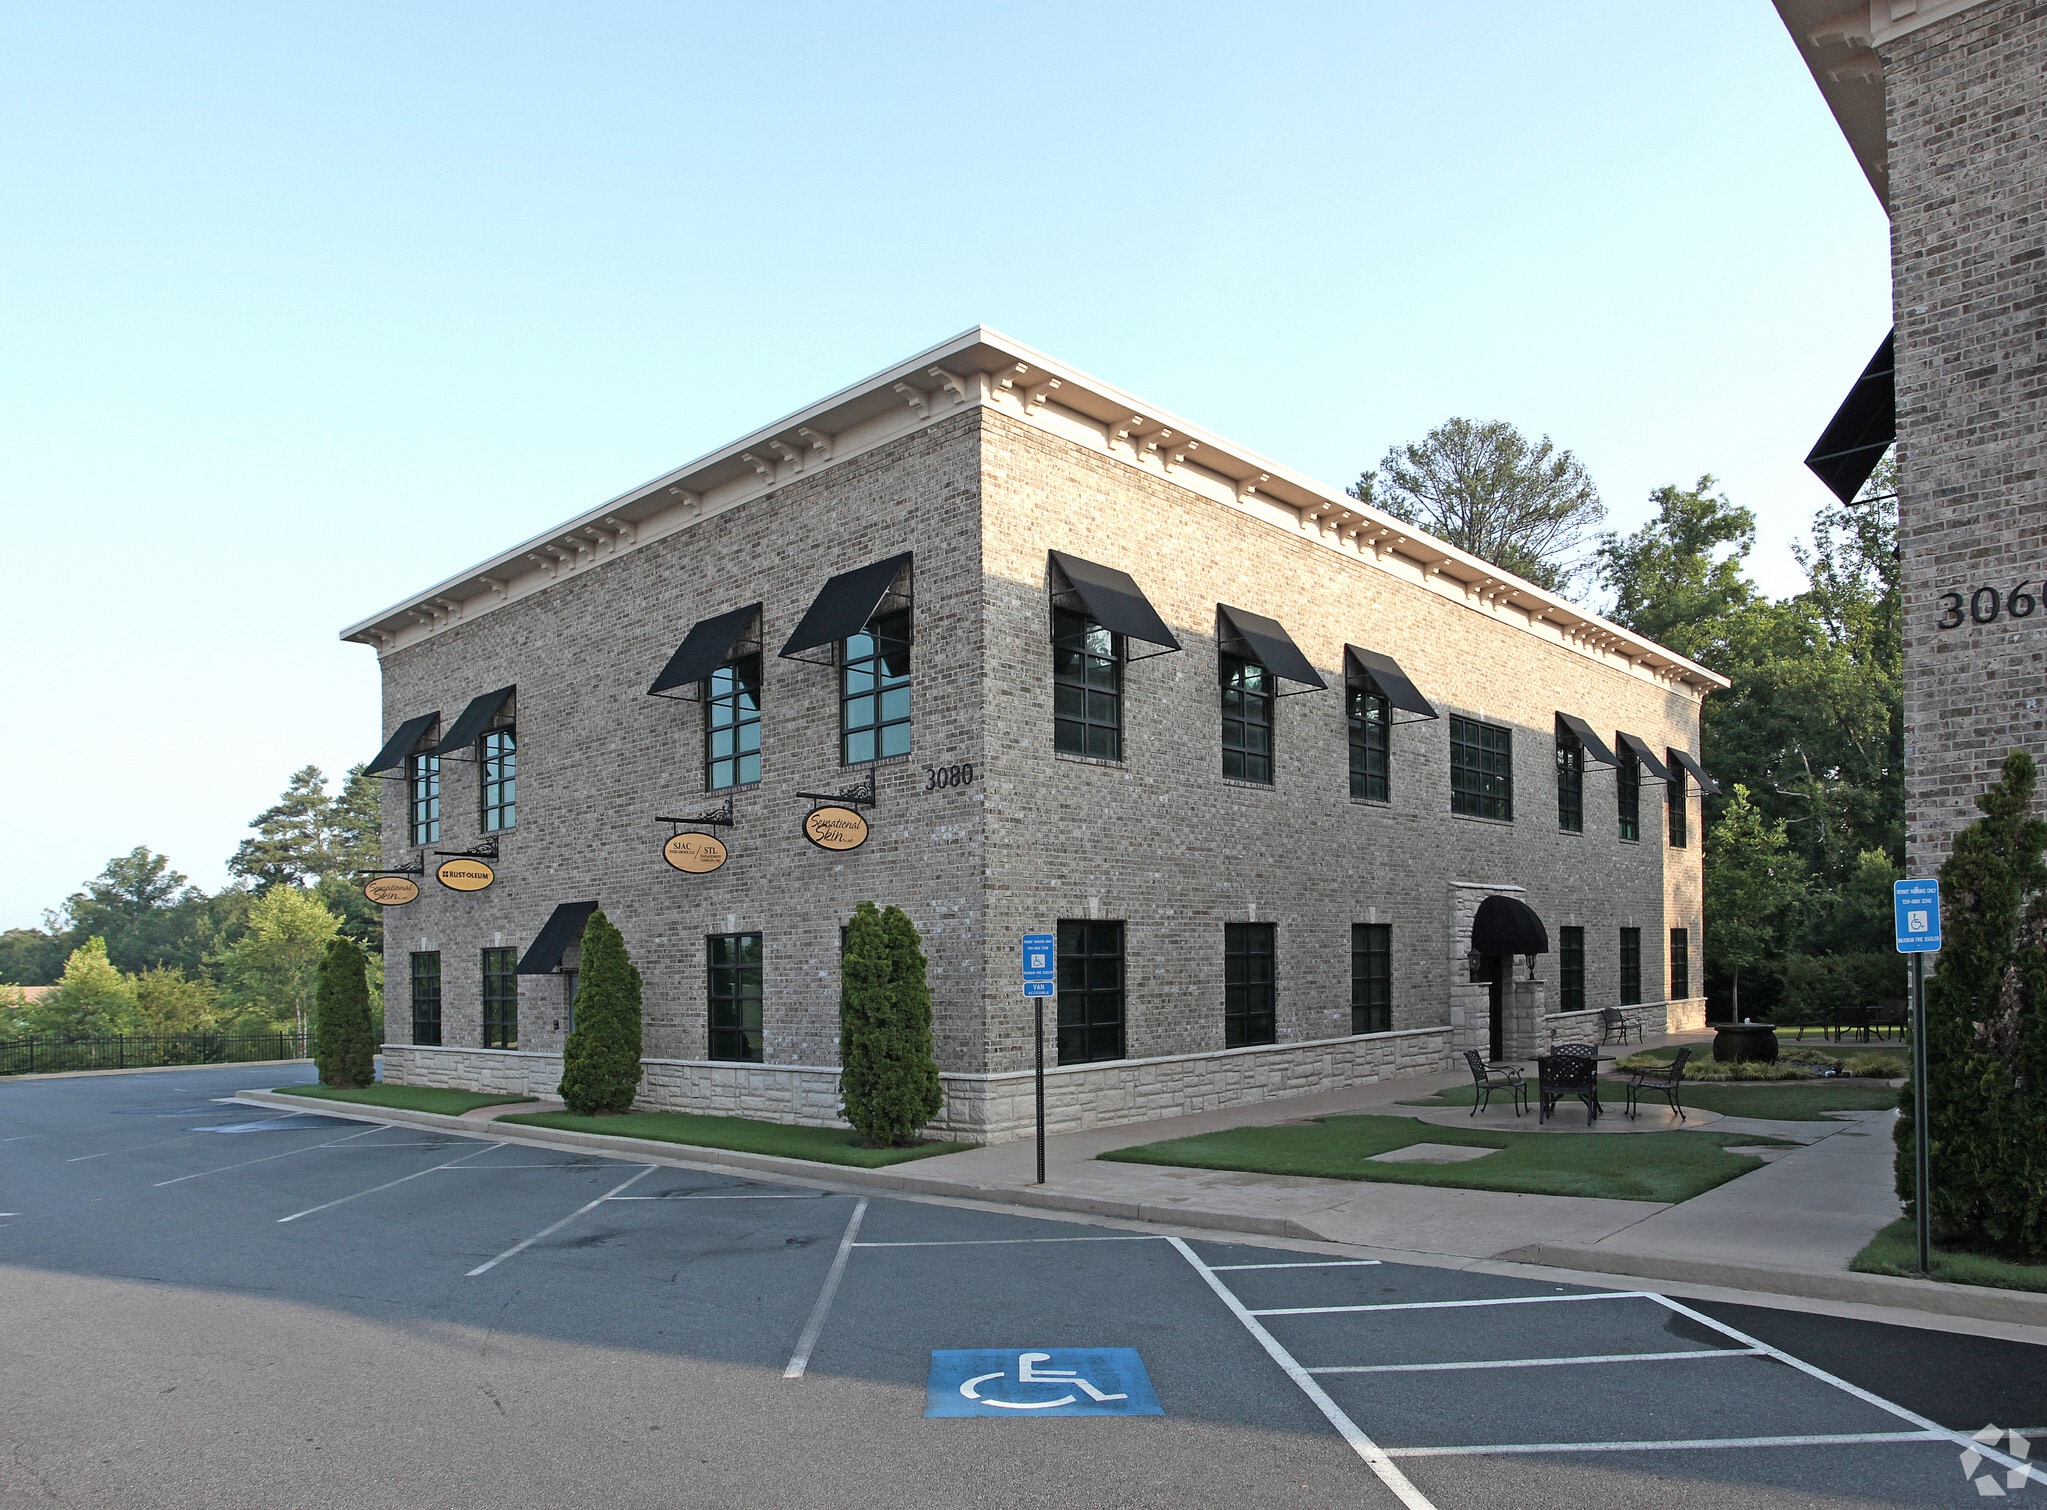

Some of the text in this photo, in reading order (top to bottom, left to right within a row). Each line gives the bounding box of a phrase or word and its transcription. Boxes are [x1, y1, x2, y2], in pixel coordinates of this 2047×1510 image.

[1938, 580, 2047, 630] 306
[926, 763, 973, 790] 3080
[811, 814, 862, 830] Sensational
[815, 825, 844, 842] Skin
[673, 842, 691, 850] SJAC
[449, 871, 489, 880] RUST-OLEUM
[369, 883, 413, 892] Sensational
[374, 890, 398, 900] Skin
